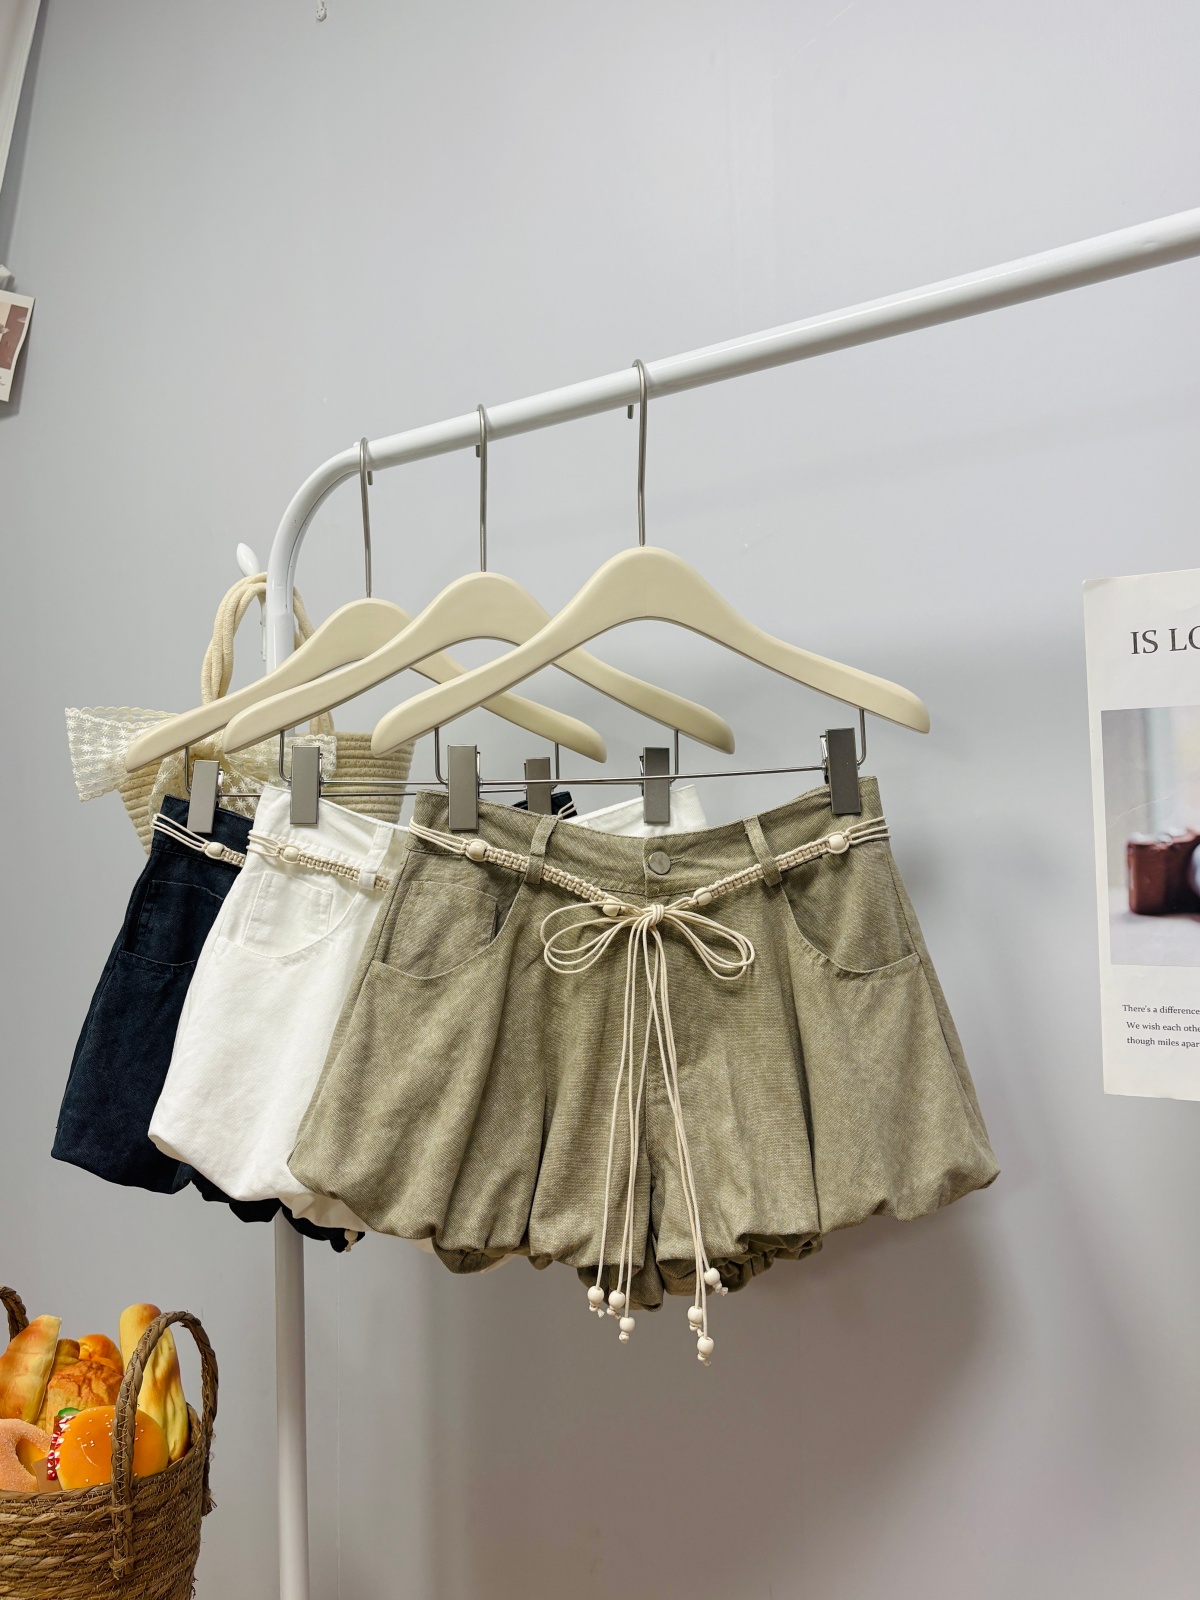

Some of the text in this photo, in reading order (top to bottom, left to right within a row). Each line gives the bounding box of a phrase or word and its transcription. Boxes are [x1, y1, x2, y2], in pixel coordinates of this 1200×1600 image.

[1130, 629, 1159, 655] IS
[1122, 1004, 1151, 1013] There's
[1126, 1021, 1140, 1030] We
[1142, 1022, 1160, 1031] wish
[1162, 1024, 1182, 1032] each
[1127, 1036, 1155, 1046] though
[1158, 1038, 1179, 1047] miles
